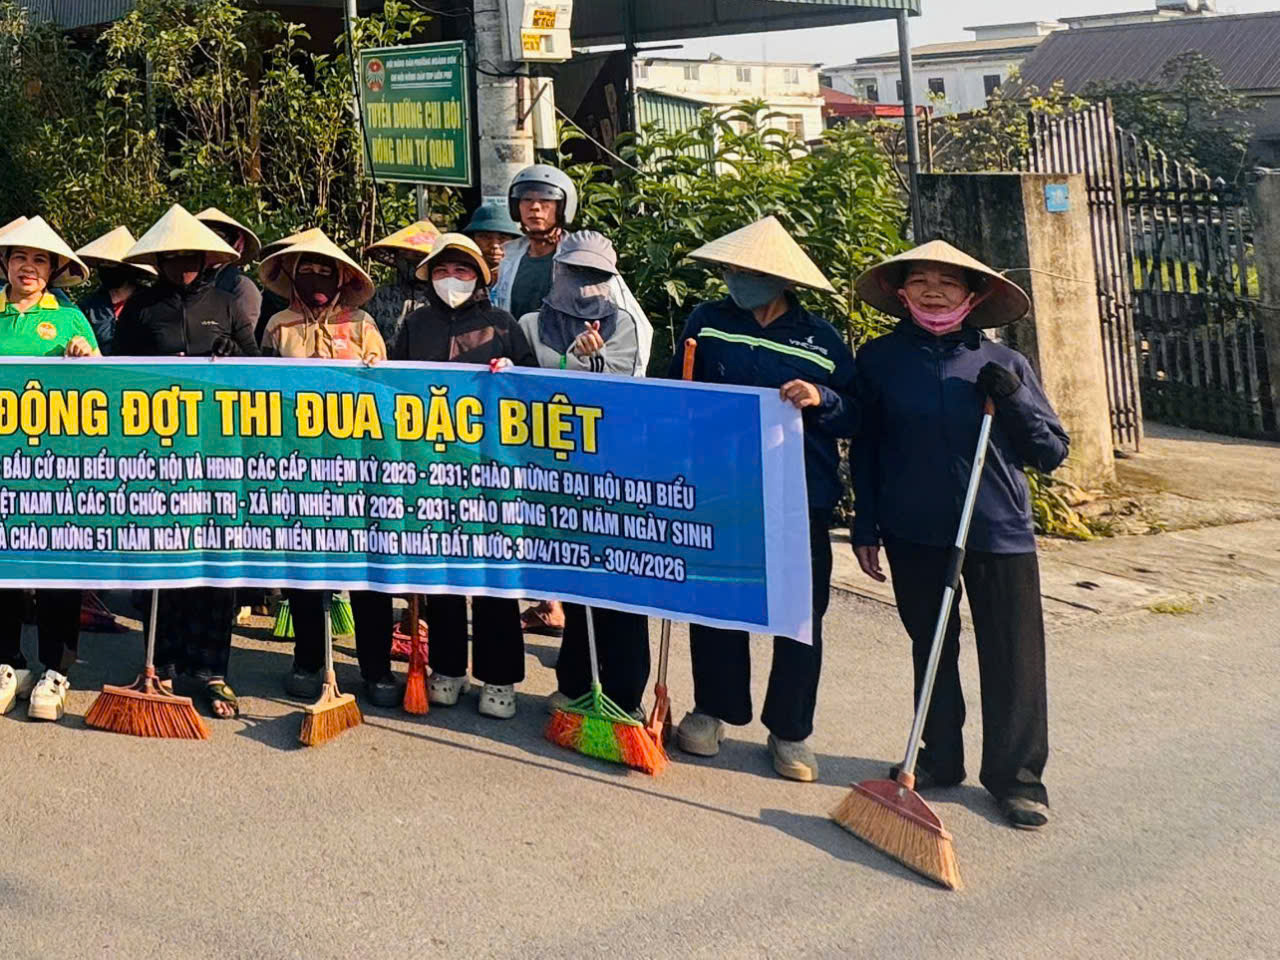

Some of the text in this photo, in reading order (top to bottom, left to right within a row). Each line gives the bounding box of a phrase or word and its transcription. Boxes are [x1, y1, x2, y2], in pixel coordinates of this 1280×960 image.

[425, 101, 441, 128] CHI
[396, 134, 413, 165] DÂN
[121, 385, 203, 446] ĐỢT
[215, 391, 281, 437] THI
[296, 391, 382, 440] ĐUA
[395, 386, 483, 452] ĐẶC
[499, 394, 602, 460] BIỆT
[3, 449, 31, 480] BẦU
[34, 449, 55, 479] CỬ
[56, 456, 80, 484] ĐẠI
[83, 448, 115, 480] BIỂU
[119, 450, 156, 482] QUỐC
[159, 453, 182, 485] HỘI
[186, 452, 204, 479] VÀ
[206, 456, 244, 480] HĐND
[247, 453, 276, 480] CÁC
[279, 450, 307, 481] CẤP
[311, 456, 356, 486] NHIỆM
[360, 456, 379, 483] KỲ
[382, 461, 417, 484] 2026
[429, 463, 468, 488] 2031;
[471, 462, 510, 489] CHÀO
[513, 464, 559, 493] MỪNG
[563, 472, 589, 500] ĐẠI
[594, 472, 620, 505] HỘI
[624, 480, 652, 508] ĐẠI
[657, 475, 695, 511] BIỂU
[20, 492, 52, 514] NAM
[56, 487, 73, 514] VÀ
[77, 488, 105, 514] CÁC
[109, 483, 126, 514] TỔ
[129, 488, 167, 515] CHỨC
[170, 488, 212, 515] CHÍNH
[215, 492, 237, 519] TRỊ
[249, 489, 269, 514] XÃ
[271, 489, 296, 520] HỘI
[299, 490, 345, 521] NHIỆM
[348, 492, 366, 517] KỲ
[370, 496, 404, 519] 2026
[417, 498, 456, 523] 2031;
[459, 494, 498, 522] CHÀO
[502, 498, 546, 527] MỪNG
[550, 506, 578, 530] 120
[582, 507, 619, 536] NĂM
[623, 513, 667, 542] NGÀY
[671, 521, 713, 549] SINH
[10, 523, 48, 550] CHÀO
[51, 523, 94, 550] MỪNG
[96, 527, 112, 550] 51
[117, 524, 151, 550] NĂM
[153, 523, 191, 550] NGÀY
[194, 521, 221, 550] GIẢI
[275, 521, 312, 551] MIỀN
[316, 529, 348, 552] NAM
[351, 523, 399, 555] THỐNG
[401, 525, 438, 556] NHẤT
[441, 526, 469, 556] ĐẤT
[473, 532, 512, 560] NƯỚC
[515, 538, 590, 567] 30/4/1975
[605, 549, 685, 581] 30/4/2026
